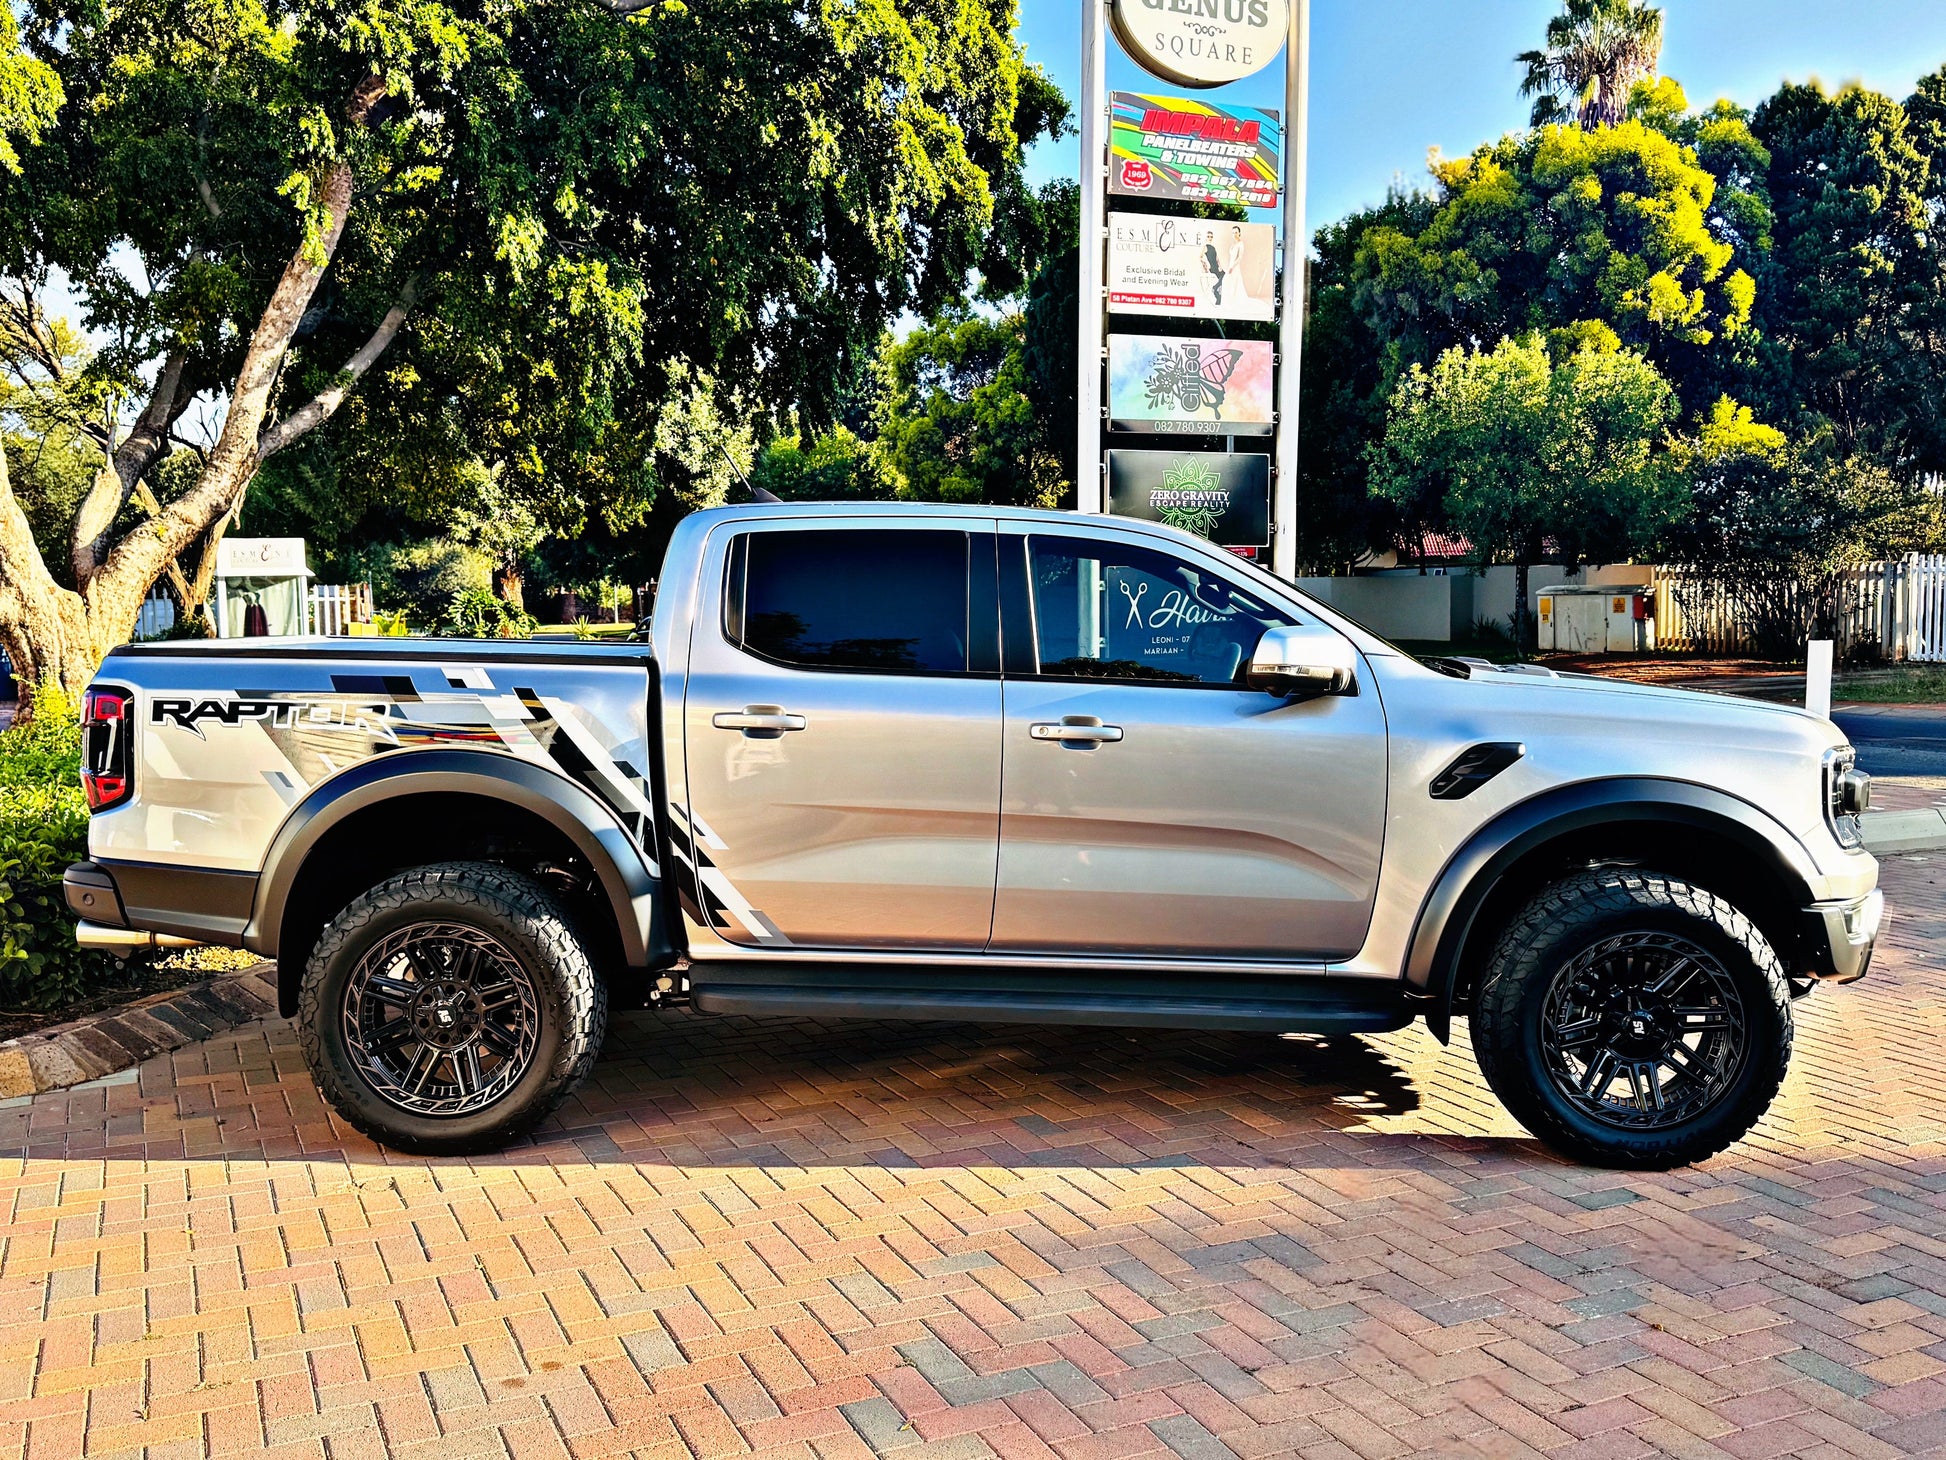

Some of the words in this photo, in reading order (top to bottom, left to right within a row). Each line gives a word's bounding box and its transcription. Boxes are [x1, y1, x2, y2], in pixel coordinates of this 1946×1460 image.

[1155, 32, 1253, 65] SQUARE
[1140, 108, 1260, 144] IMPALA
[1142, 134, 1257, 158] PANELBEATERS
[1160, 150, 1174, 163] &
[1176, 151, 1238, 169] TOWING
[1127, 170, 1147, 178] 1969
[1116, 242, 1155, 253] COUTURE
[1126, 265, 1162, 275] Exclusive
[1164, 268, 1186, 277] Bridal
[1122, 276, 1136, 284] and
[1138, 277, 1168, 287] Evening
[1170, 278, 1189, 287] Wear
[1181, 344, 1201, 412] Gifted
[1154, 421, 1173, 432] 082
[1176, 421, 1195, 433] 780
[1197, 422, 1221, 433] 9307
[1149, 490, 1180, 500] ZERO
[1181, 490, 1230, 501] GRAVITY
[1151, 636, 1174, 644] LEONI
[1144, 647, 1178, 655] MARIAAN
[150, 697, 402, 747] RAPTOR
